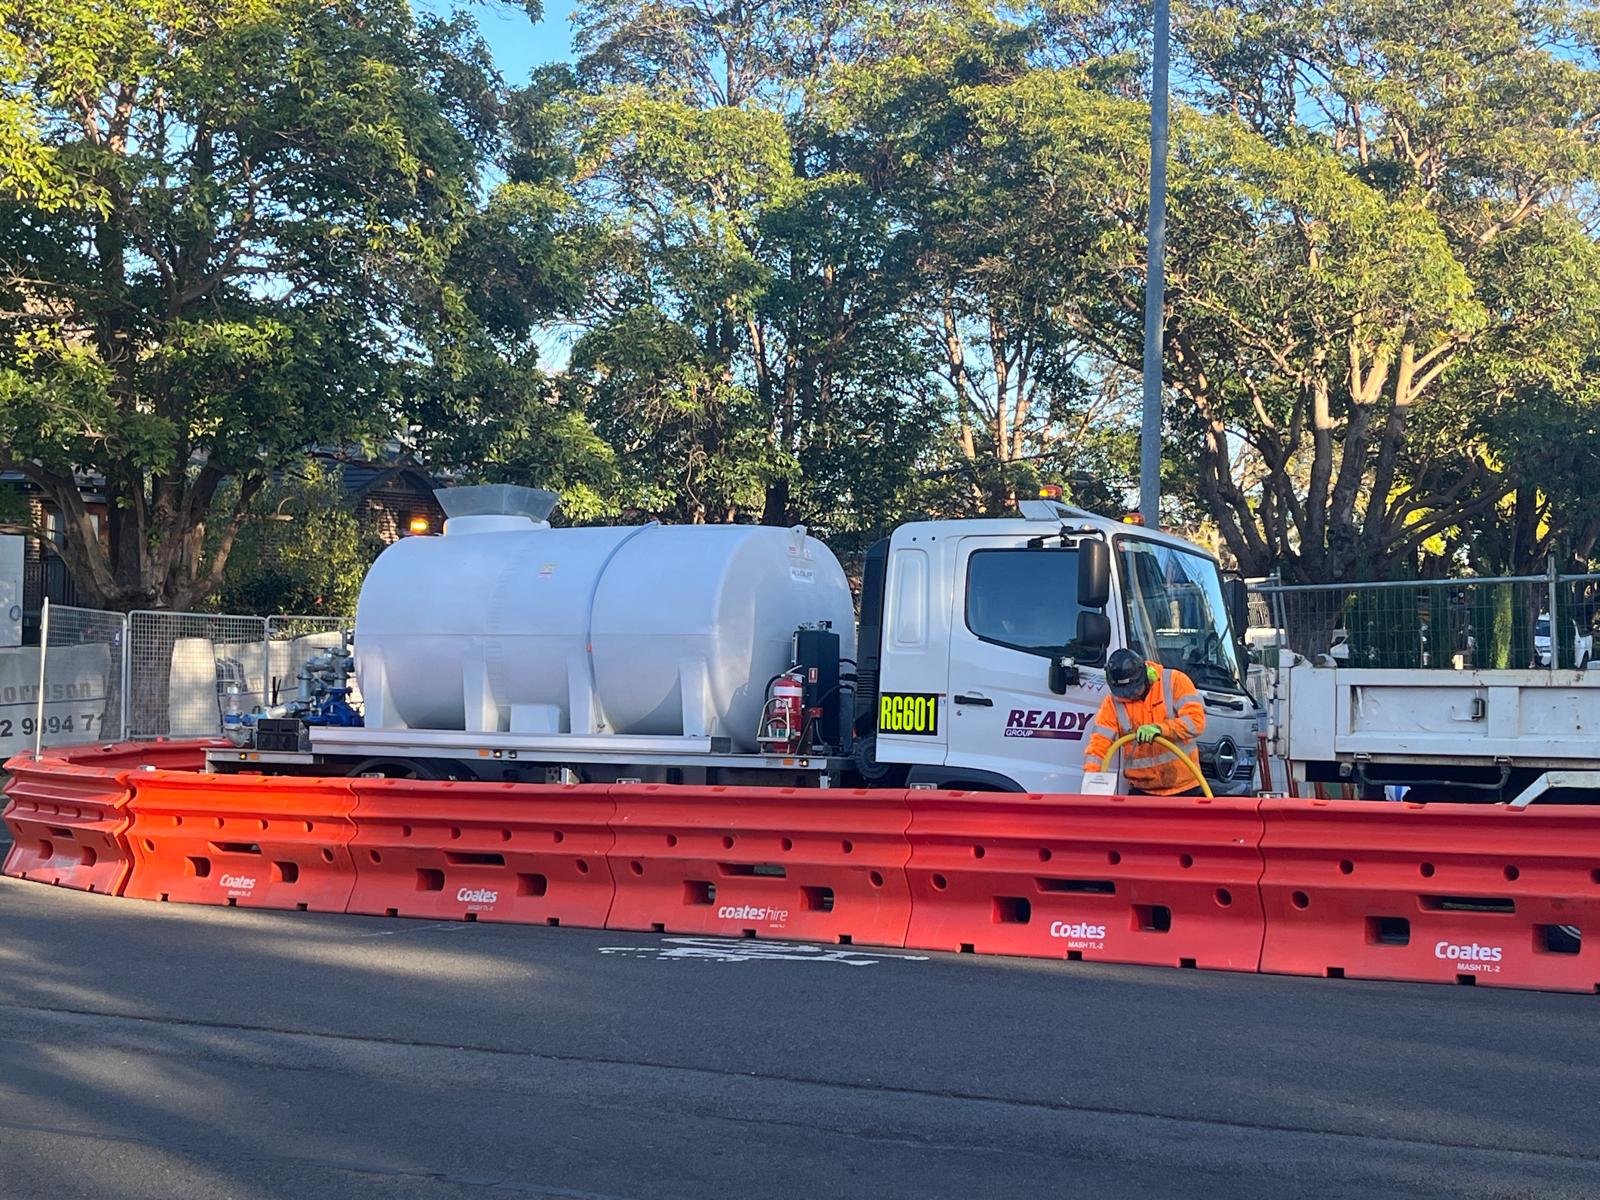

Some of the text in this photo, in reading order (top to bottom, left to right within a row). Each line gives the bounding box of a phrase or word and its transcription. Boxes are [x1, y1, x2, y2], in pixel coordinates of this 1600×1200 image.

[880, 696, 936, 732] RG601
[1006, 709, 1094, 730] READY
[1005, 729, 1033, 737] GROUP
[219, 874, 256, 889] Coates
[457, 887, 498, 903] Coates
[1050, 921, 1106, 939] Coates
[1068, 941, 1088, 949] MASH
[1435, 941, 1502, 961] Coates
[1457, 963, 1500, 972] MASH TL-2
